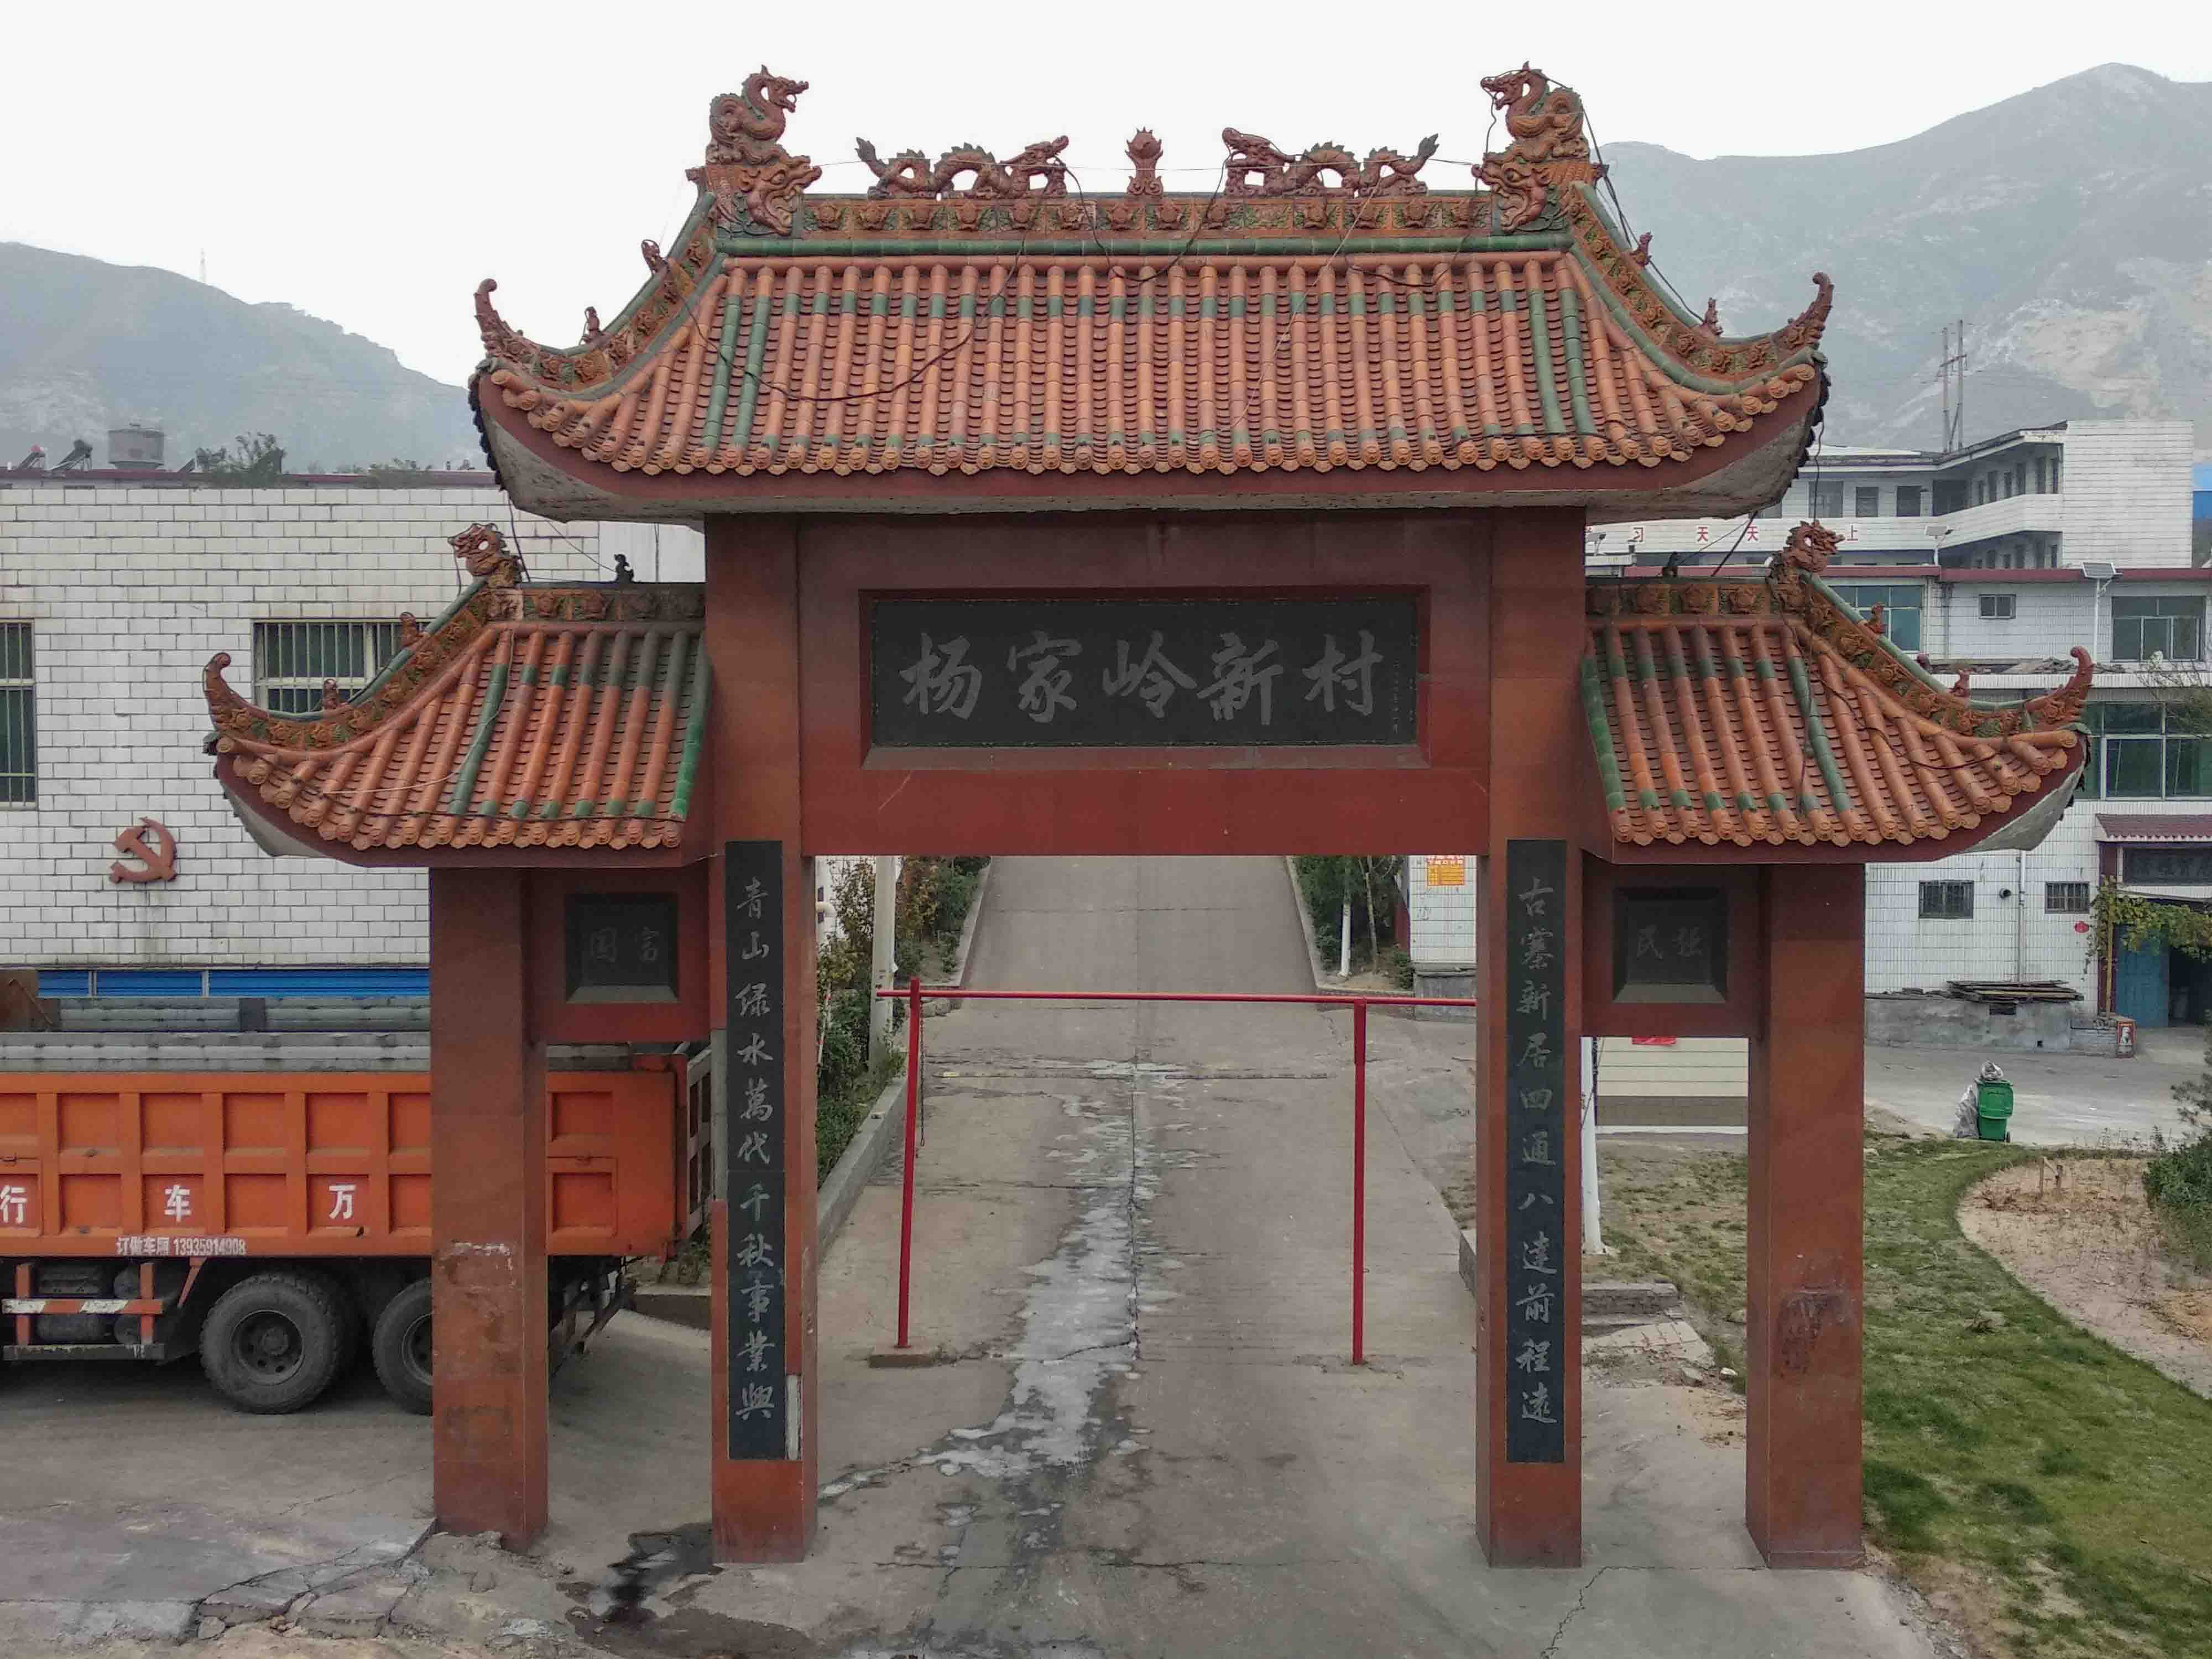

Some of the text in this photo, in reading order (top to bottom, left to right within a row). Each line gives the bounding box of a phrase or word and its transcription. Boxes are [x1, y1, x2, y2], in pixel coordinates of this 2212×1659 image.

[900, 632, 1383, 726] 杨家岭新村
[165, 1185, 191, 1222] 车
[329, 1185, 356, 1219] 万
